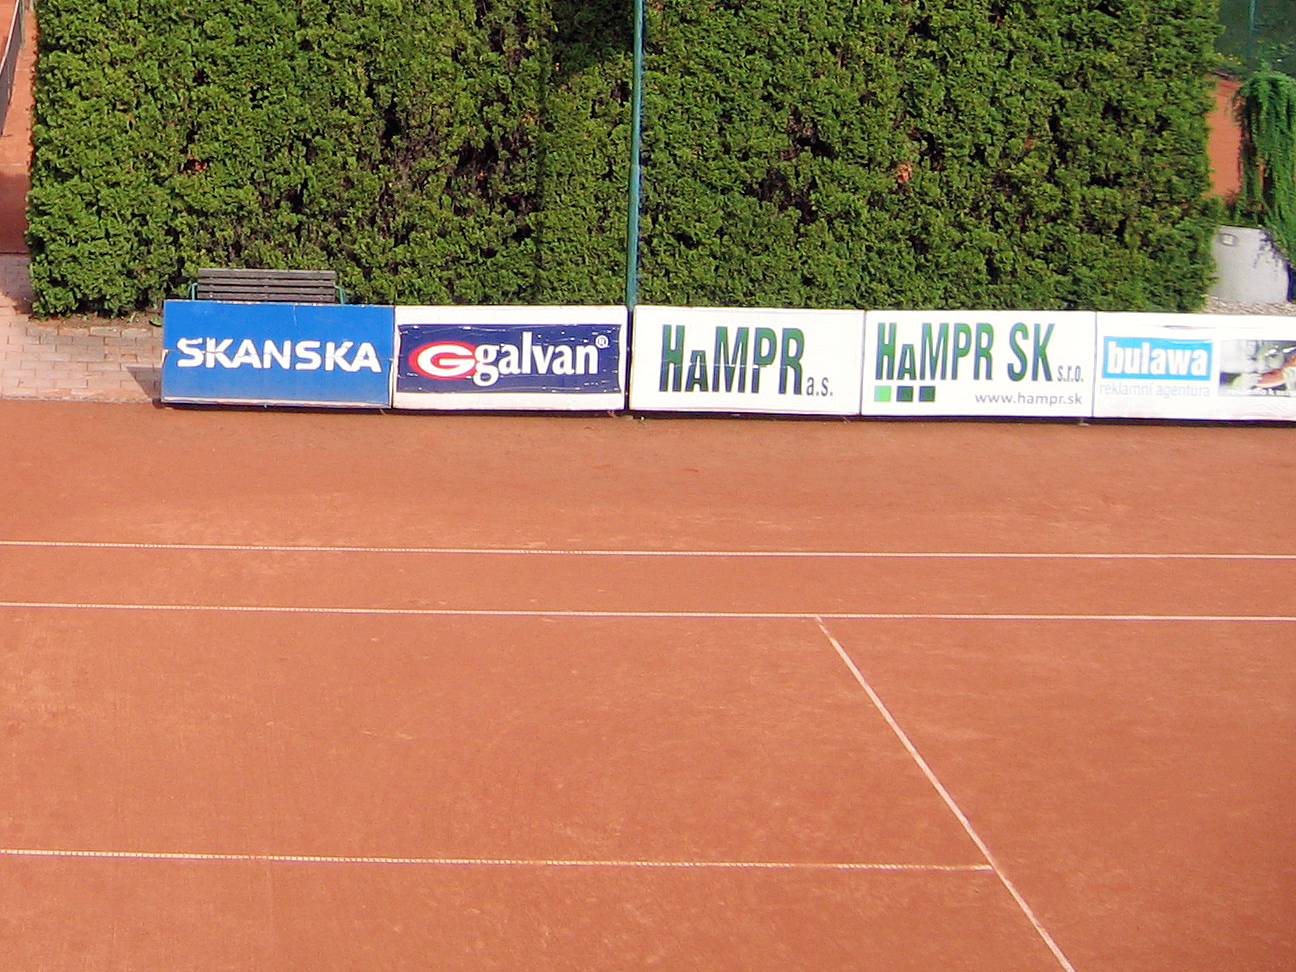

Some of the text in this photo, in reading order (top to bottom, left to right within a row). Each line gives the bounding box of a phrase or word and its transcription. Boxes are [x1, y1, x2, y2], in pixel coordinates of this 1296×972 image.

[176, 337, 382, 373] SKANSKA
[1007, 322, 1056, 382] SK
[1057, 365, 1084, 383] s.r.o.
[1107, 340, 1209, 376] bulawa
[806, 376, 834, 397] a.s.
[975, 391, 1083, 407] www.hampr.sk
[1156, 384, 1211, 399] agentura
